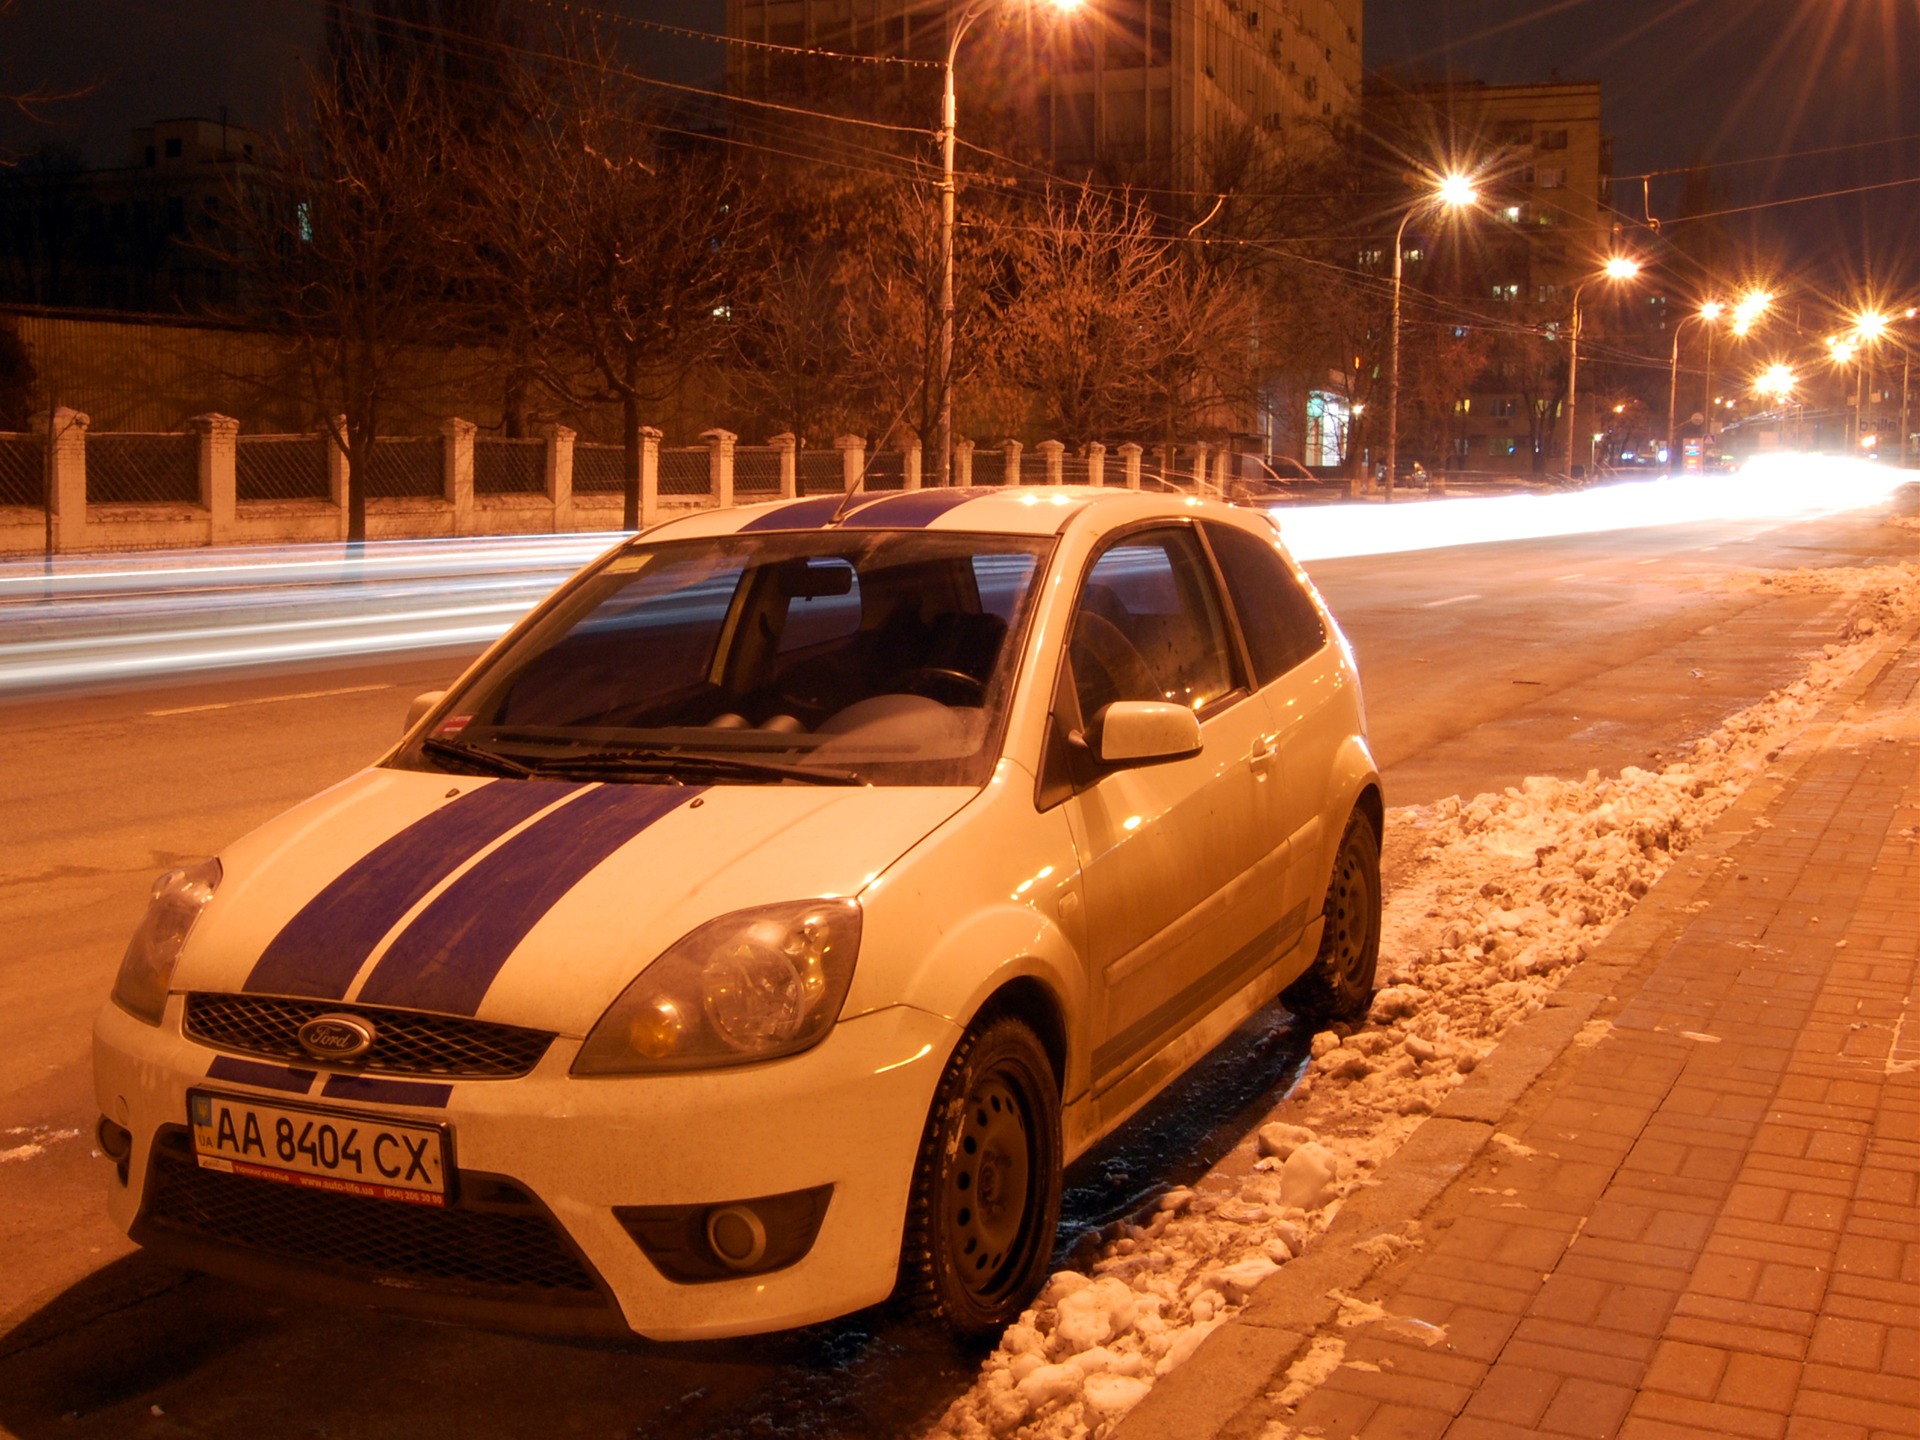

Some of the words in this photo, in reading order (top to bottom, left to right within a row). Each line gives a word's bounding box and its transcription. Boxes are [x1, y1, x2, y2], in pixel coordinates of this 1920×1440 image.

[310, 1024, 351, 1048] Ford
[198, 1134, 213, 1148] UA
[217, 1107, 266, 1158] AA
[276, 1117, 362, 1174] 8404
[373, 1132, 432, 1184] CX
[300, 1177, 374, 1196] www.auto-life.ua
